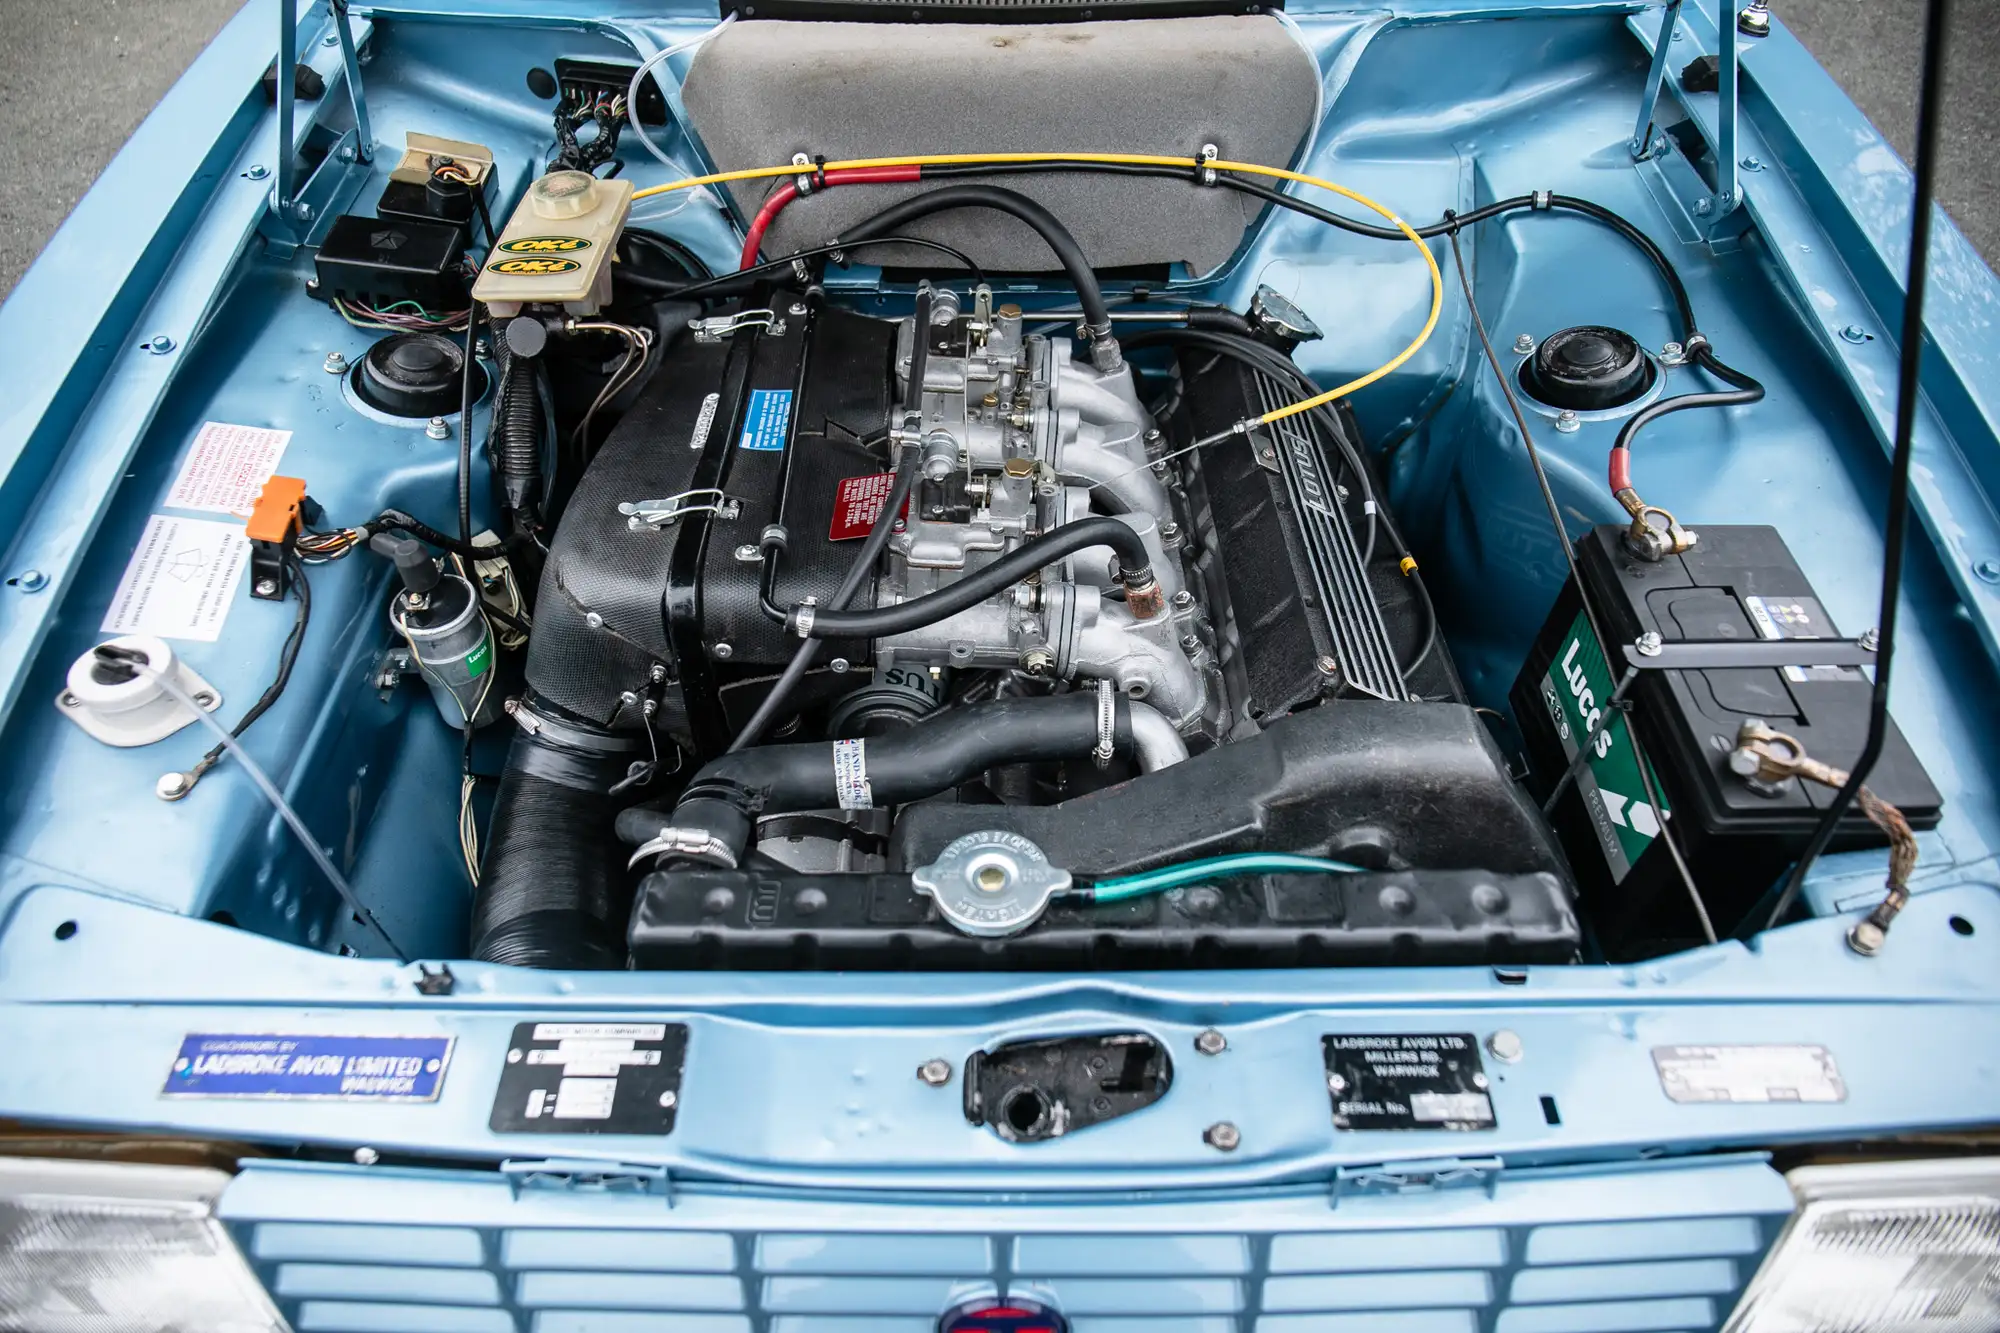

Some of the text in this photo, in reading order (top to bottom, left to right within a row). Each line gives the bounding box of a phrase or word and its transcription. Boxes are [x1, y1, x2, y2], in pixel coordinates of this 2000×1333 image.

[1290, 437, 1327, 511] LOTUS
[1588, 789, 1618, 857] PREMIUM
[1333, 1037, 1468, 1050] LADBROKE AVON LTD.
[1364, 1051, 1443, 1063] MILLERS RD.
[192, 1054, 423, 1077] LADBROKE AVON LIMITED
[1372, 1064, 1440, 1078] WARWICK
[1339, 1101, 1385, 1115] SERIAL
